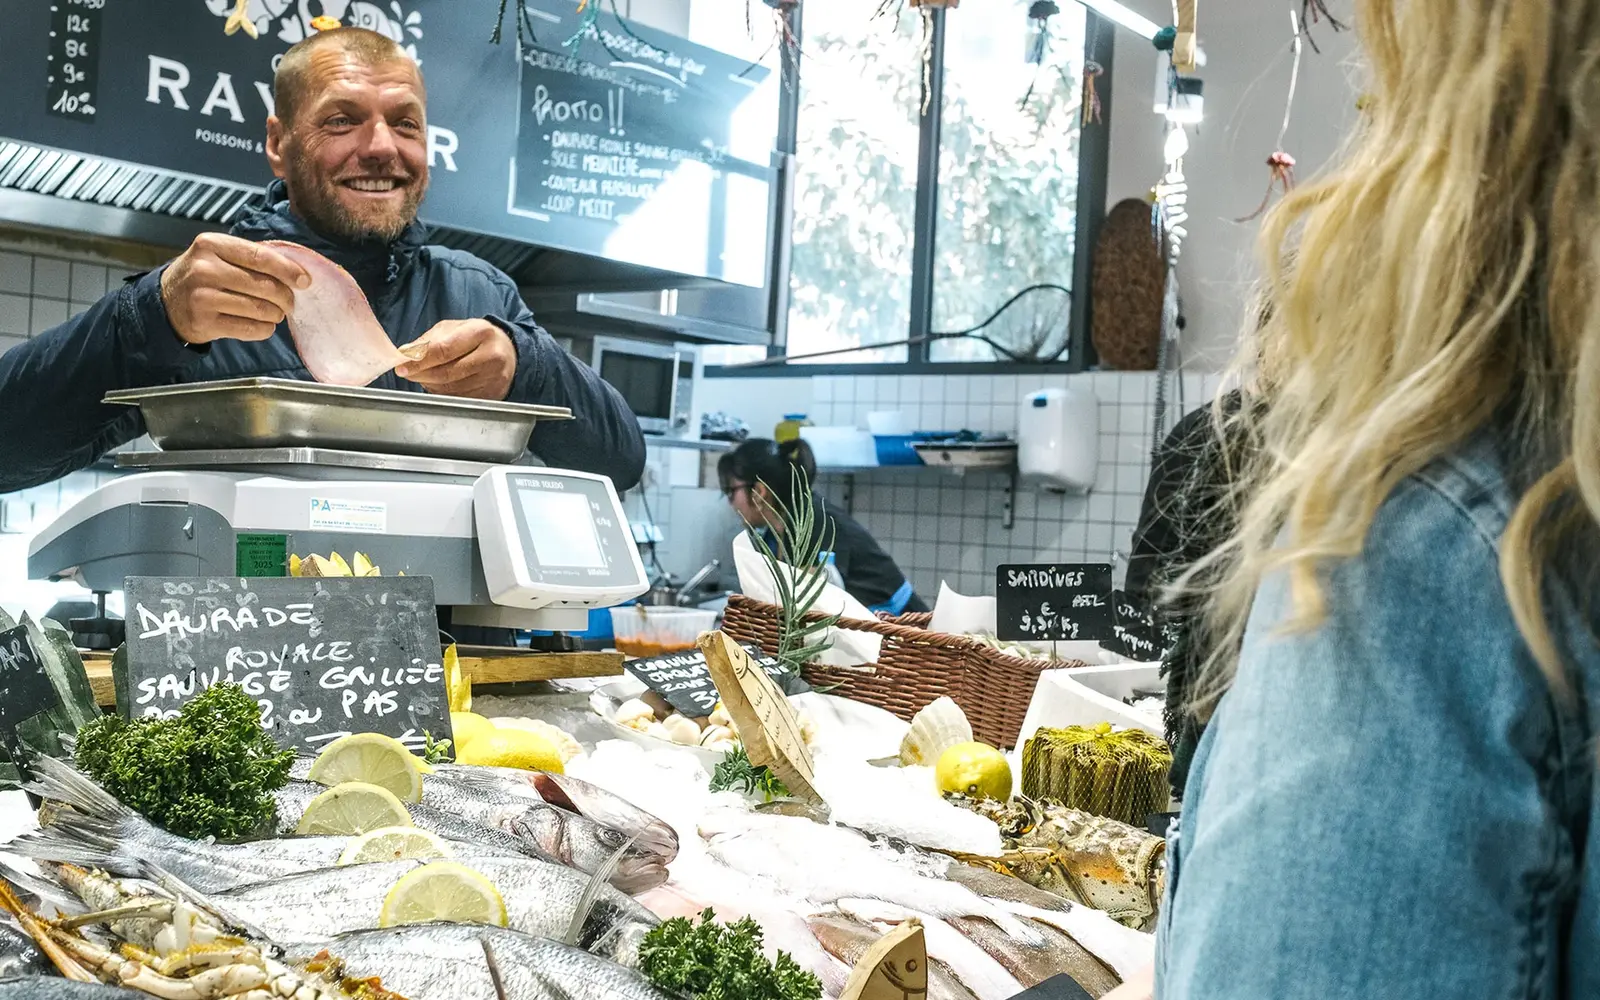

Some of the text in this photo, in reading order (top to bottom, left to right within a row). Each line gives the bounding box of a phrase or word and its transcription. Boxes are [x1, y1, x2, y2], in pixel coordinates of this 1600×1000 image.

[195, 128, 263, 154] POISSONS &
[253, 561, 273, 569] 2025
[1008, 567, 1085, 588] SARDINES
[136, 602, 314, 640] DAURADE
[225, 641, 355, 673] ROYALE
